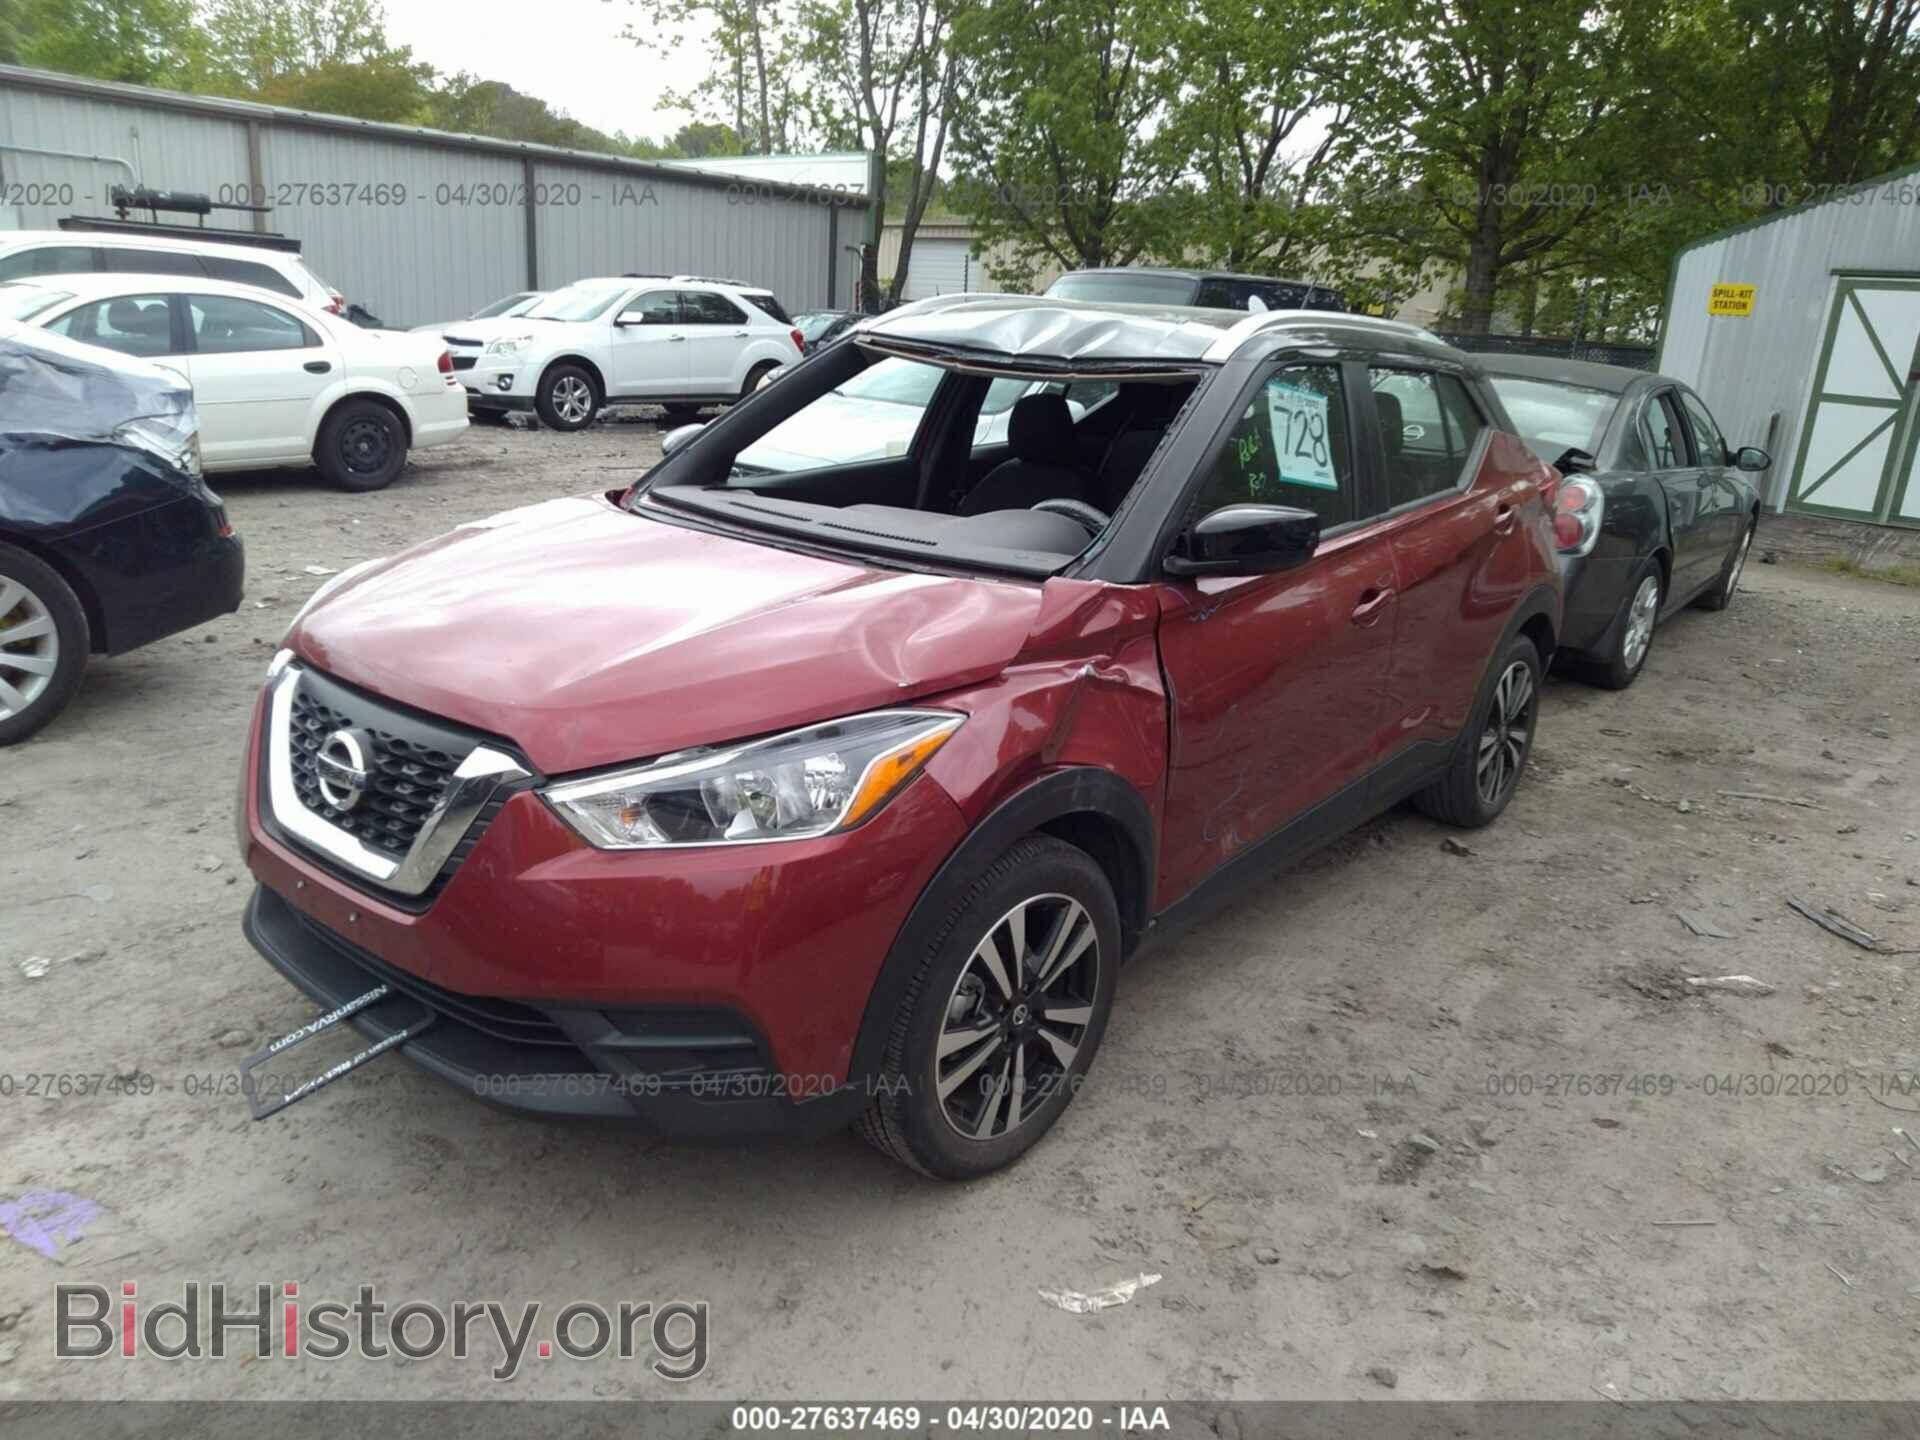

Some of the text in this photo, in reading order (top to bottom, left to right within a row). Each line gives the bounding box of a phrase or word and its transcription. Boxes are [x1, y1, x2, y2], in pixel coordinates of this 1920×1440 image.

[1712, 288, 1754, 298] SPILL-KIT
[1713, 300, 1748, 310] STATION
[1273, 405, 1328, 467] 728
[269, 984, 388, 1052] NissanRVA.com
